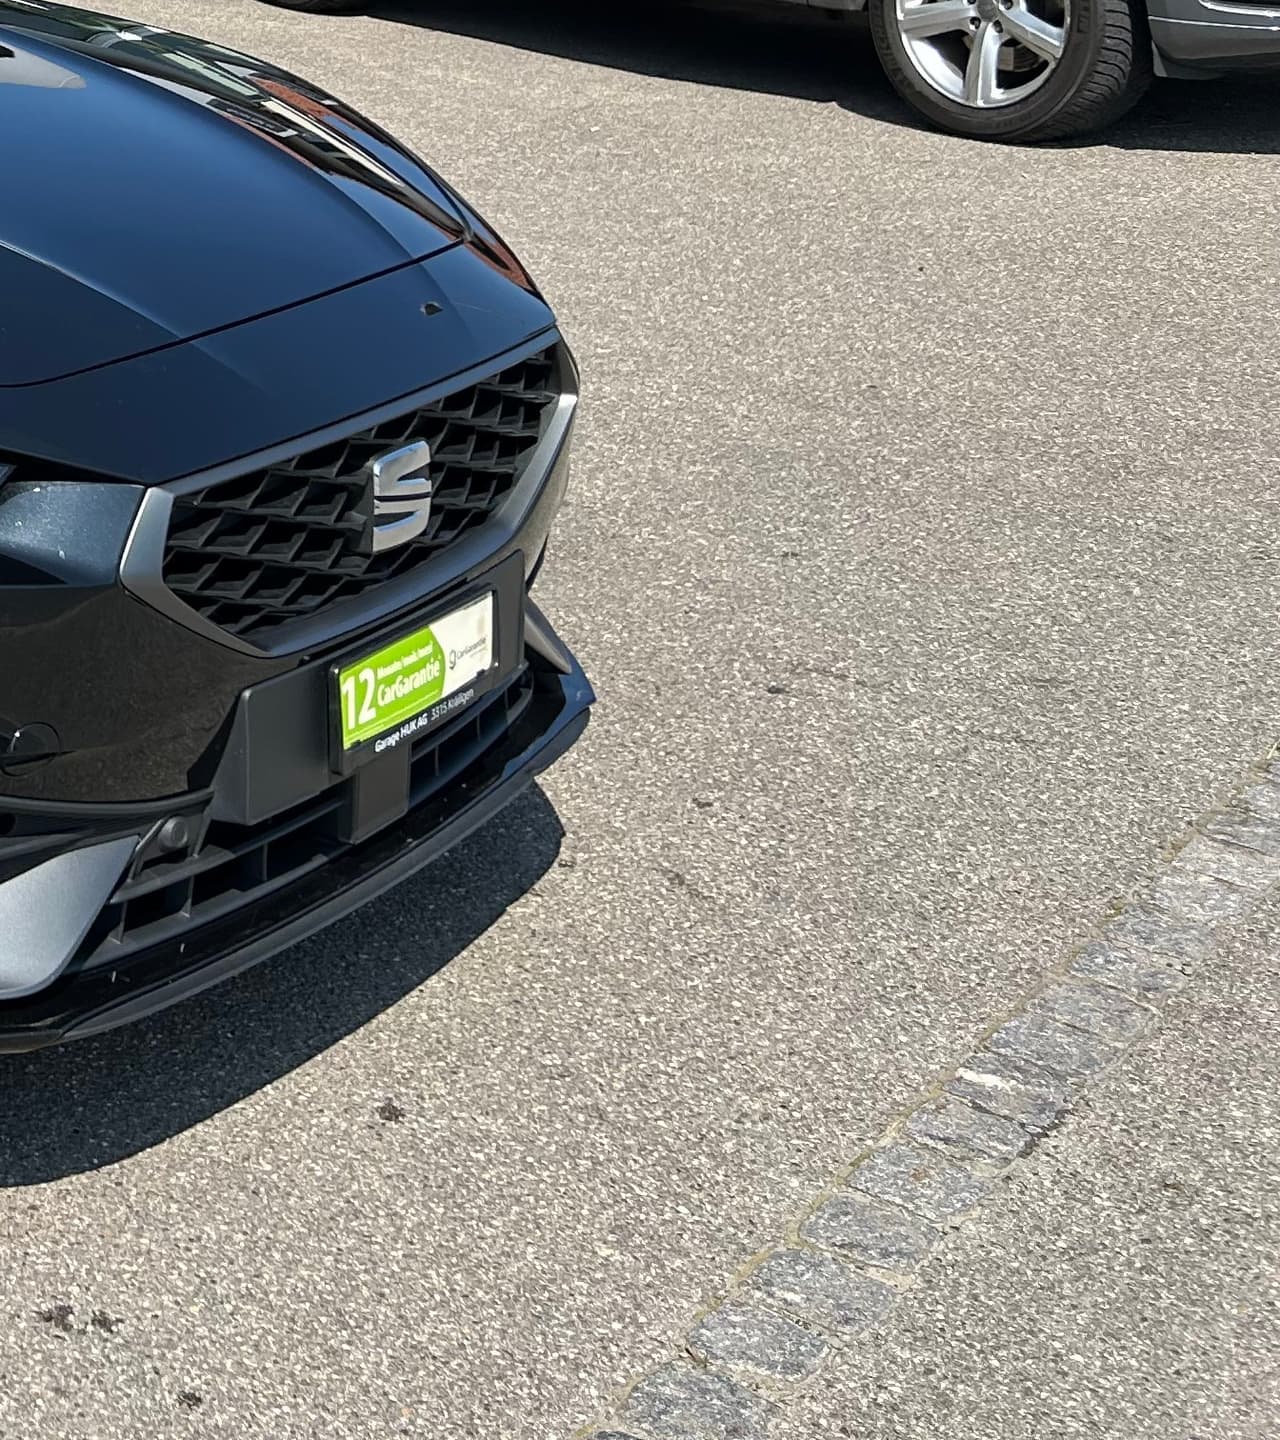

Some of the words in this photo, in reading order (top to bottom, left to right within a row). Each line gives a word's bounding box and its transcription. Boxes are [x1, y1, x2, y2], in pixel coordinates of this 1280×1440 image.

[342, 667, 377, 731] 12
[377, 656, 440, 707] CarGarantie
[374, 731, 401, 753] Garage
